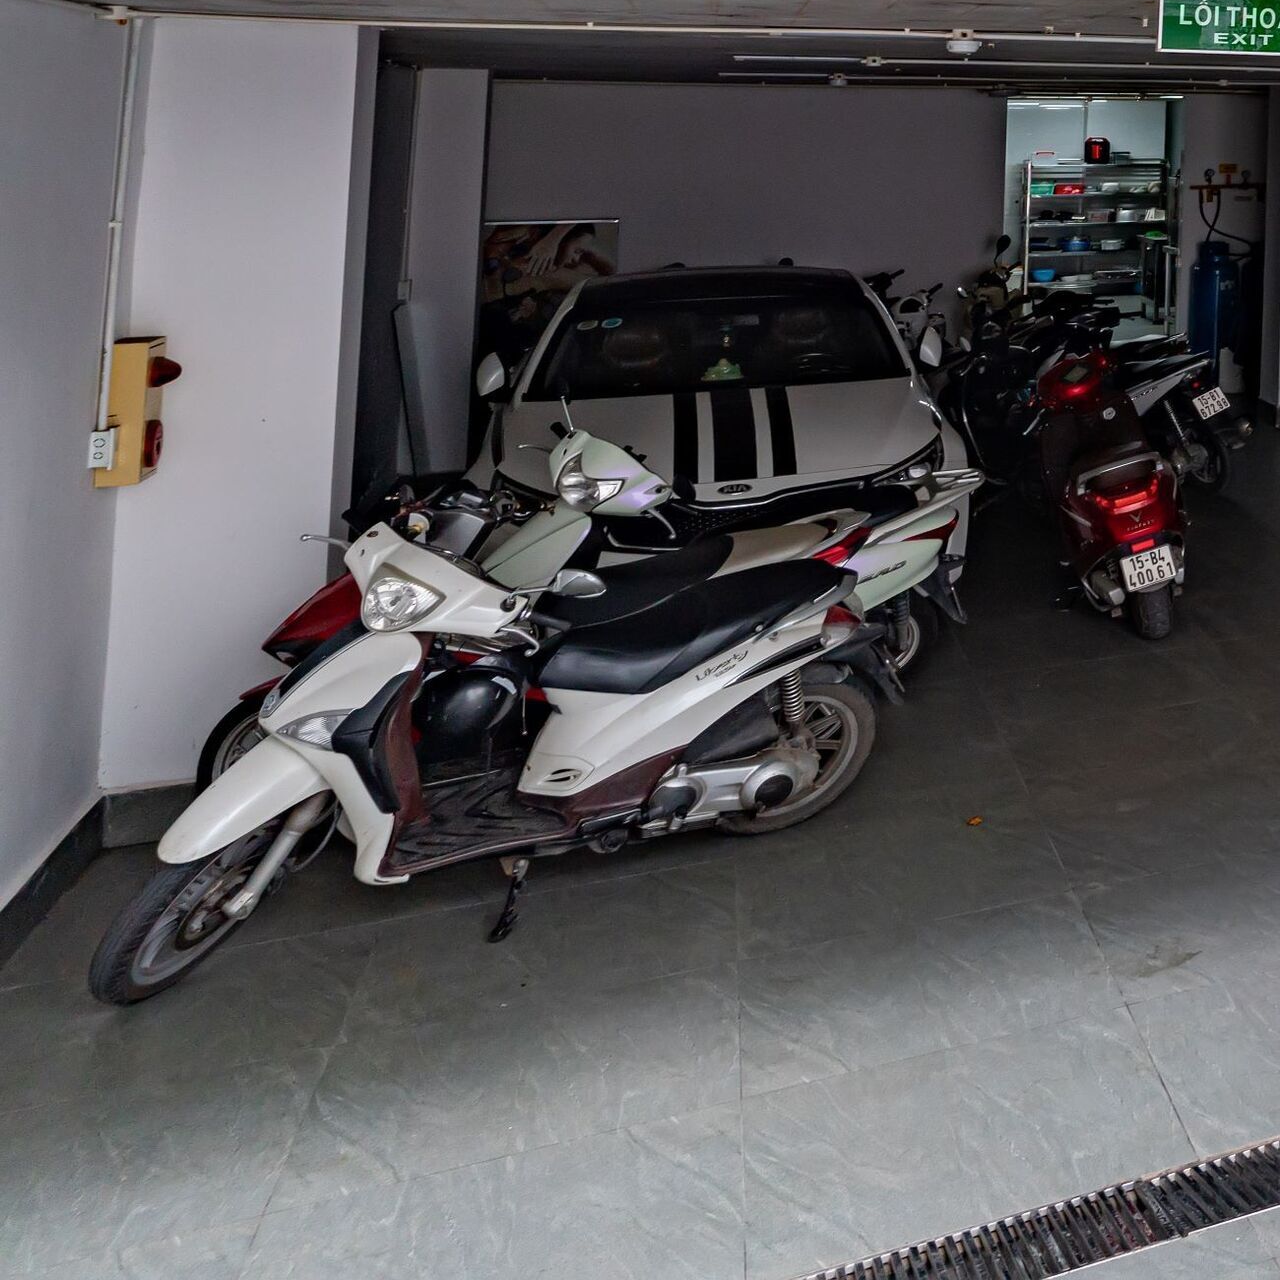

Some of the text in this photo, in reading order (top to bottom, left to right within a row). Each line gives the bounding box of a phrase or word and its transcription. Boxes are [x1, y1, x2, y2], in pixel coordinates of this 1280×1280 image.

[1213, 32, 1274, 46] EXIT
[1129, 549, 1165, 571] 15-B4
[1129, 562, 1174, 588] 400.61
